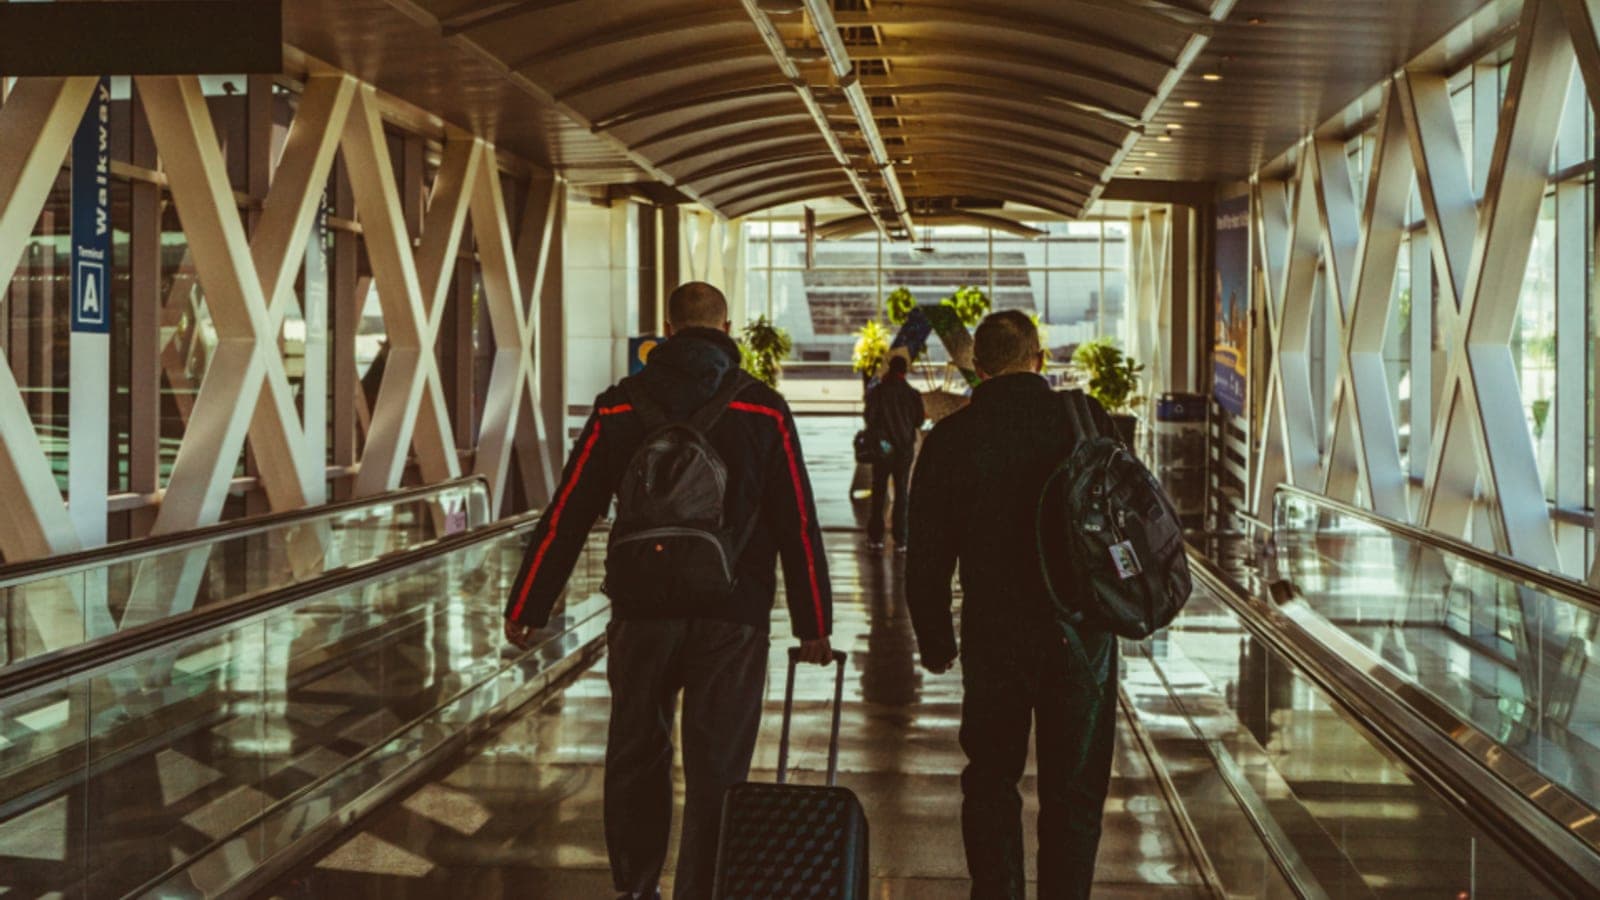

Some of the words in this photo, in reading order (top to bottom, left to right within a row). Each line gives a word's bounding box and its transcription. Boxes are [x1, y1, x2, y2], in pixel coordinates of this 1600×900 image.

[96, 83, 110, 236] Walkway
[78, 245, 104, 260] Terminal
[83, 273, 98, 313] A
